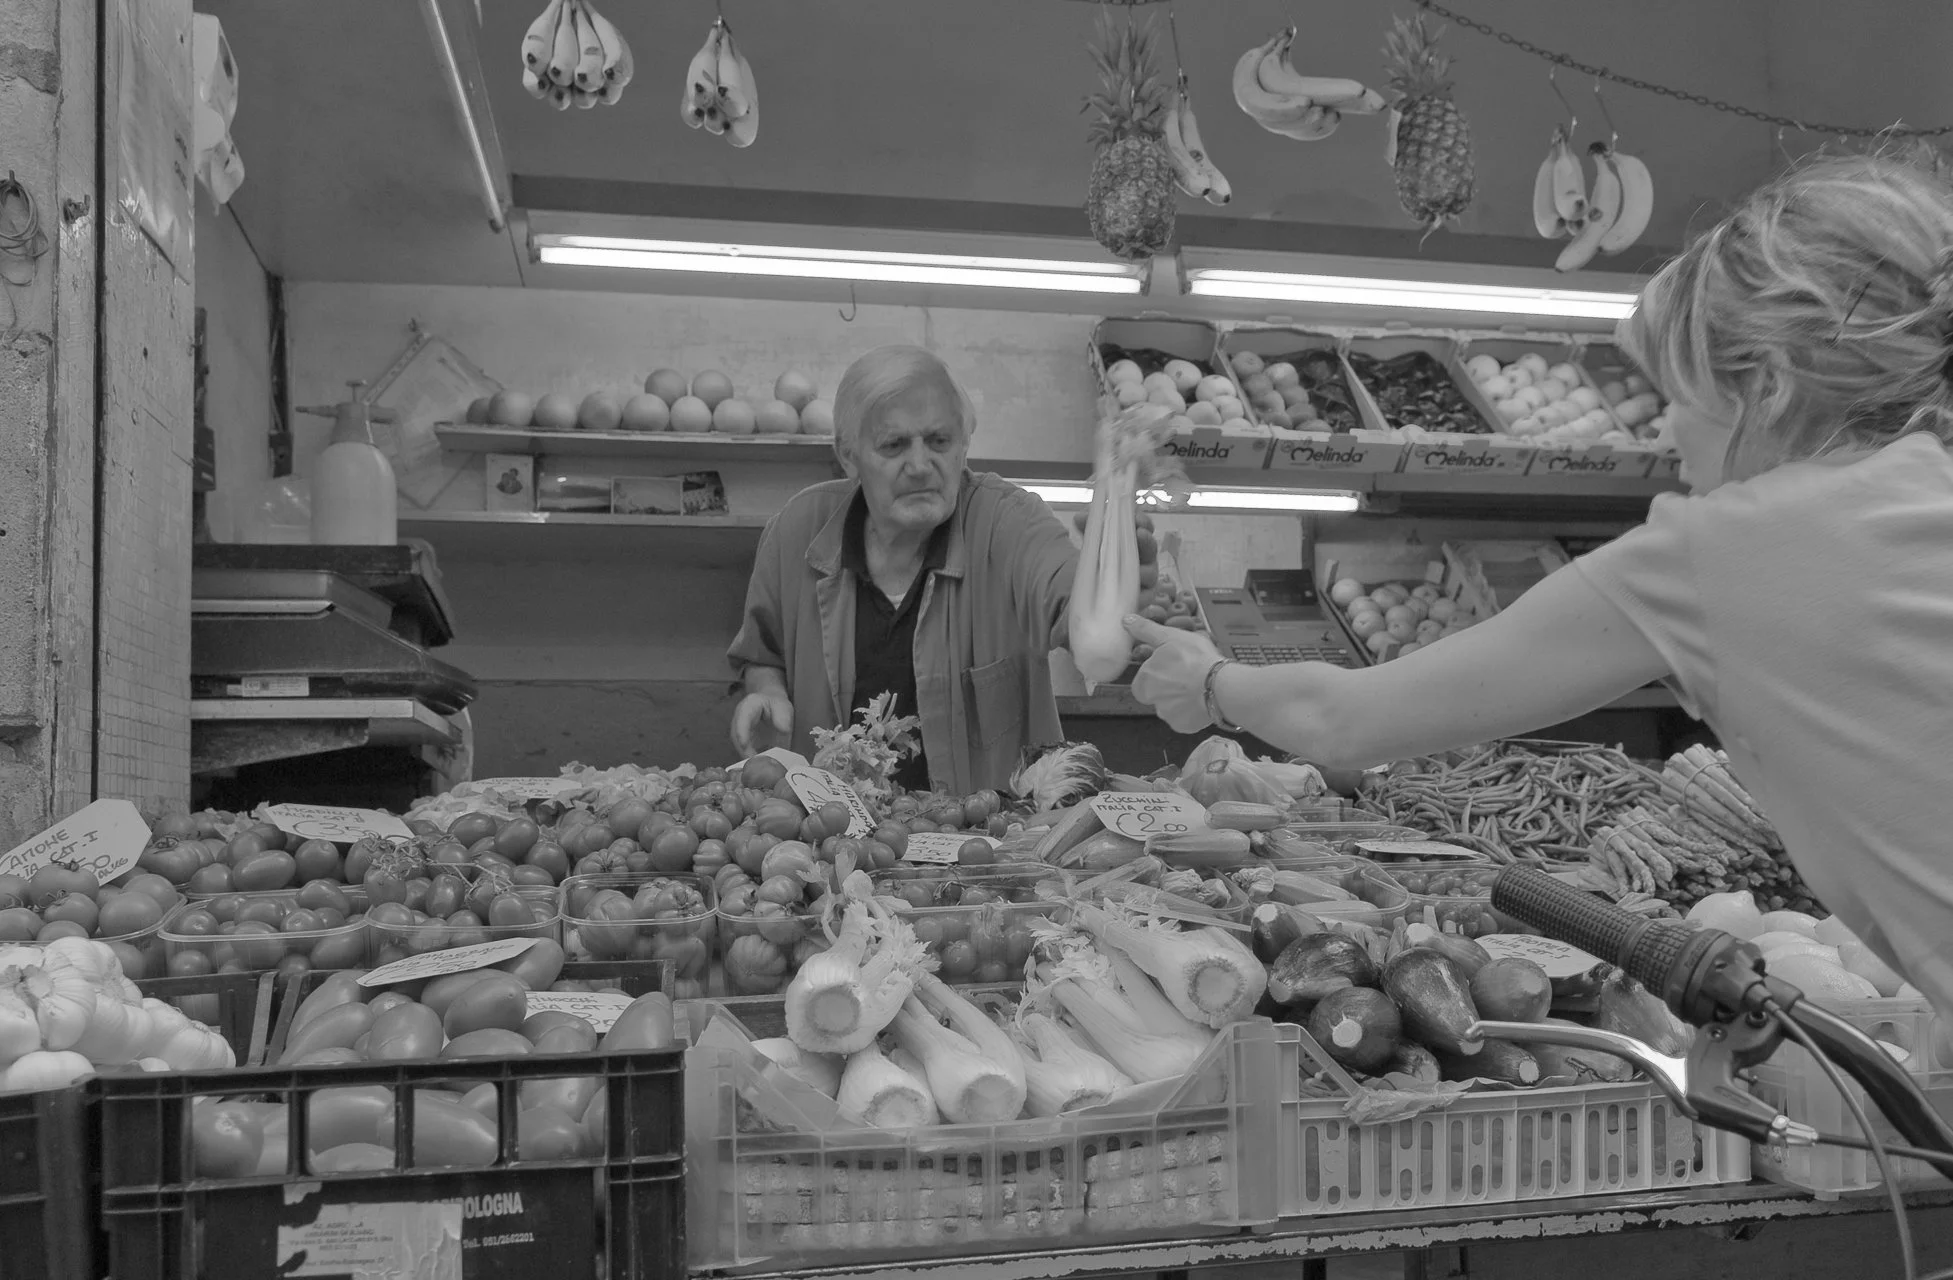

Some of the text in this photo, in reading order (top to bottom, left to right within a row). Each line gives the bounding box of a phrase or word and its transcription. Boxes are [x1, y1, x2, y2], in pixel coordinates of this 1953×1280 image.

[1291, 446, 1364, 463] Melinda
[1425, 450, 1495, 467] Melinda
[1548, 455, 1617, 472] Melinda
[1097, 803, 1137, 812] ITALIA
